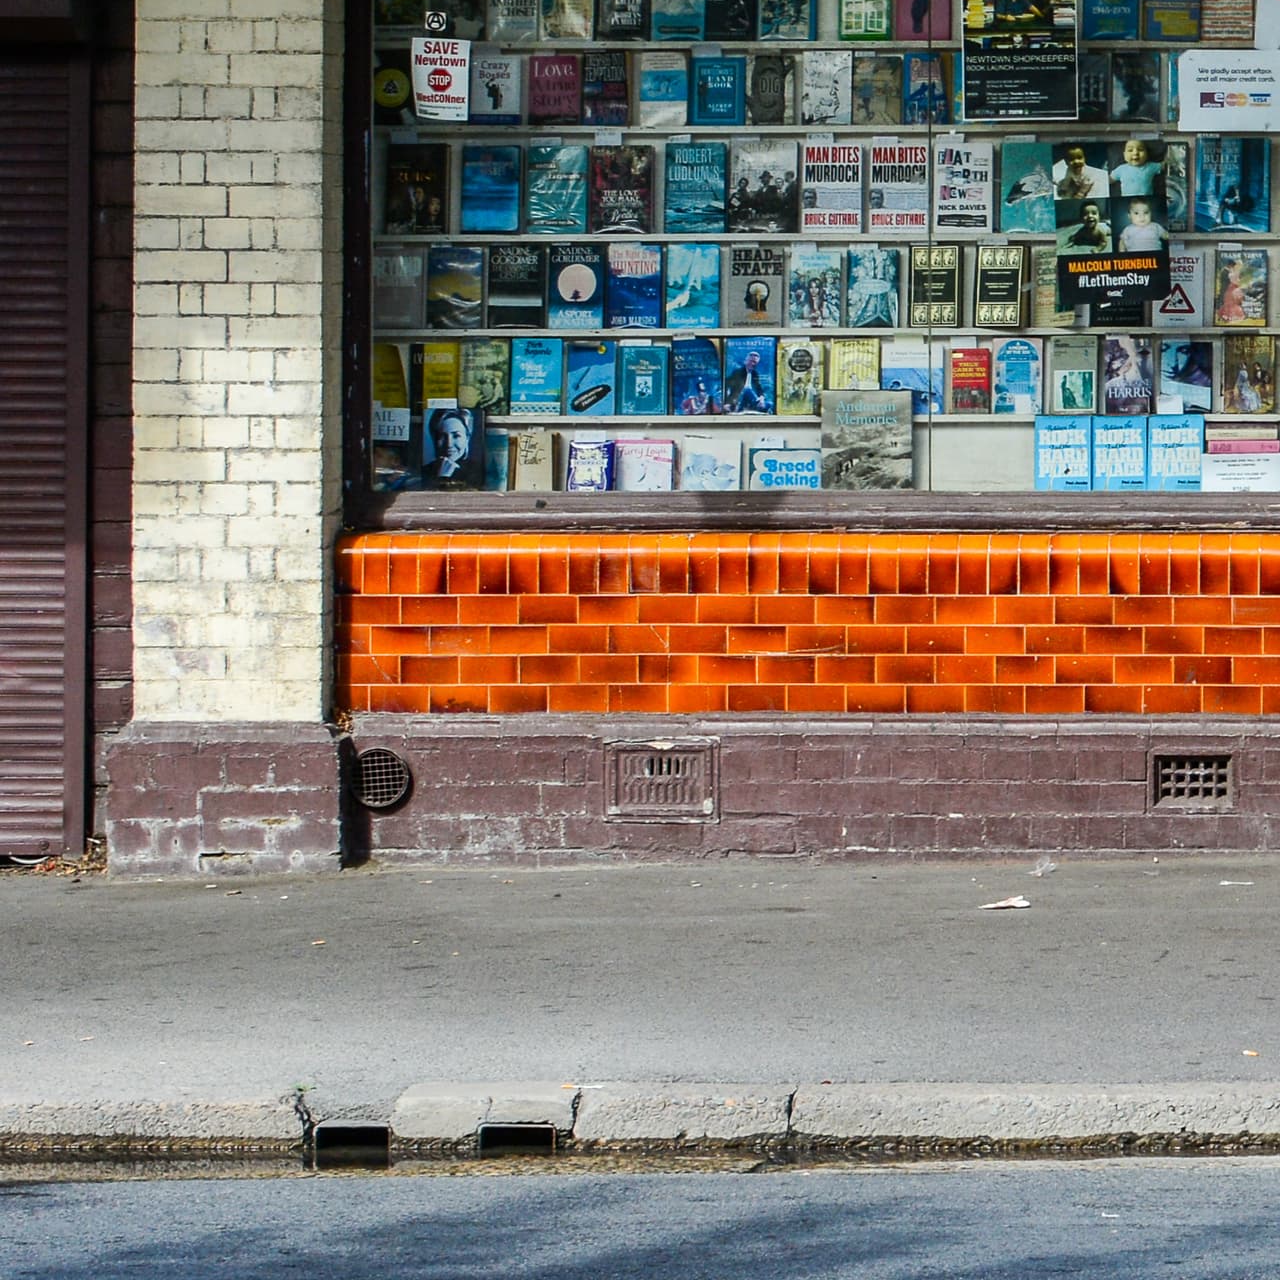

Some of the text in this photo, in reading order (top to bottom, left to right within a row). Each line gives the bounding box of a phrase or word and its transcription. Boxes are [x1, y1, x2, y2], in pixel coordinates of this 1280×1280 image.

[423, 40, 459, 55] SAVE
[414, 54, 467, 68] Newtown
[966, 54, 1075, 64] NEWTOWN SHOPKEEPERS
[428, 74, 451, 87] STOP
[416, 91, 466, 105] WestCONnex
[805, 146, 860, 163] MAN BITES
[805, 165, 860, 183] MURDOCH
[804, 213, 859, 226] BRUCE GUTHRIE
[733, 249, 772, 261] HEAD
[731, 263, 783, 276] STATE
[1068, 257, 1159, 273] MALCOLM TURNBULL
[1078, 273, 1150, 288] #LetThemStay
[1108, 386, 1152, 399] HARRIS
[763, 459, 816, 473] Bread
[759, 472, 819, 489] Baking
